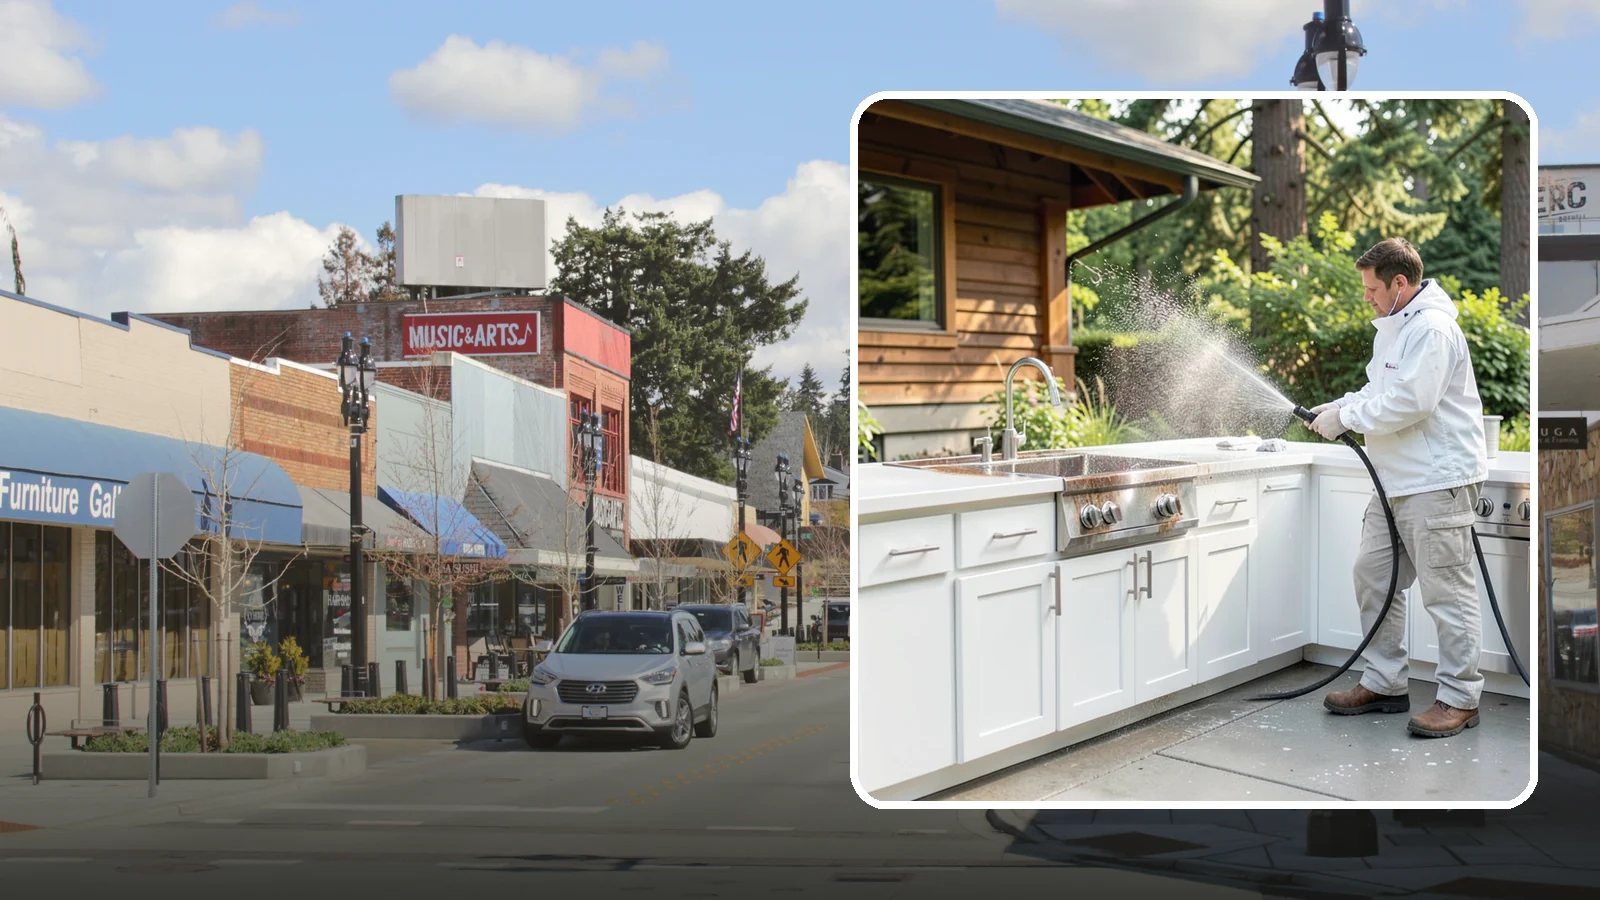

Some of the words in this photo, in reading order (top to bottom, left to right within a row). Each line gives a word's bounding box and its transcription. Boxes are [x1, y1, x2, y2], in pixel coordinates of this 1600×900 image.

[409, 322, 519, 349] MUSIC&ARTS
[0, 471, 79, 515] Furniture
[453, 564, 479, 574] SUSHI
